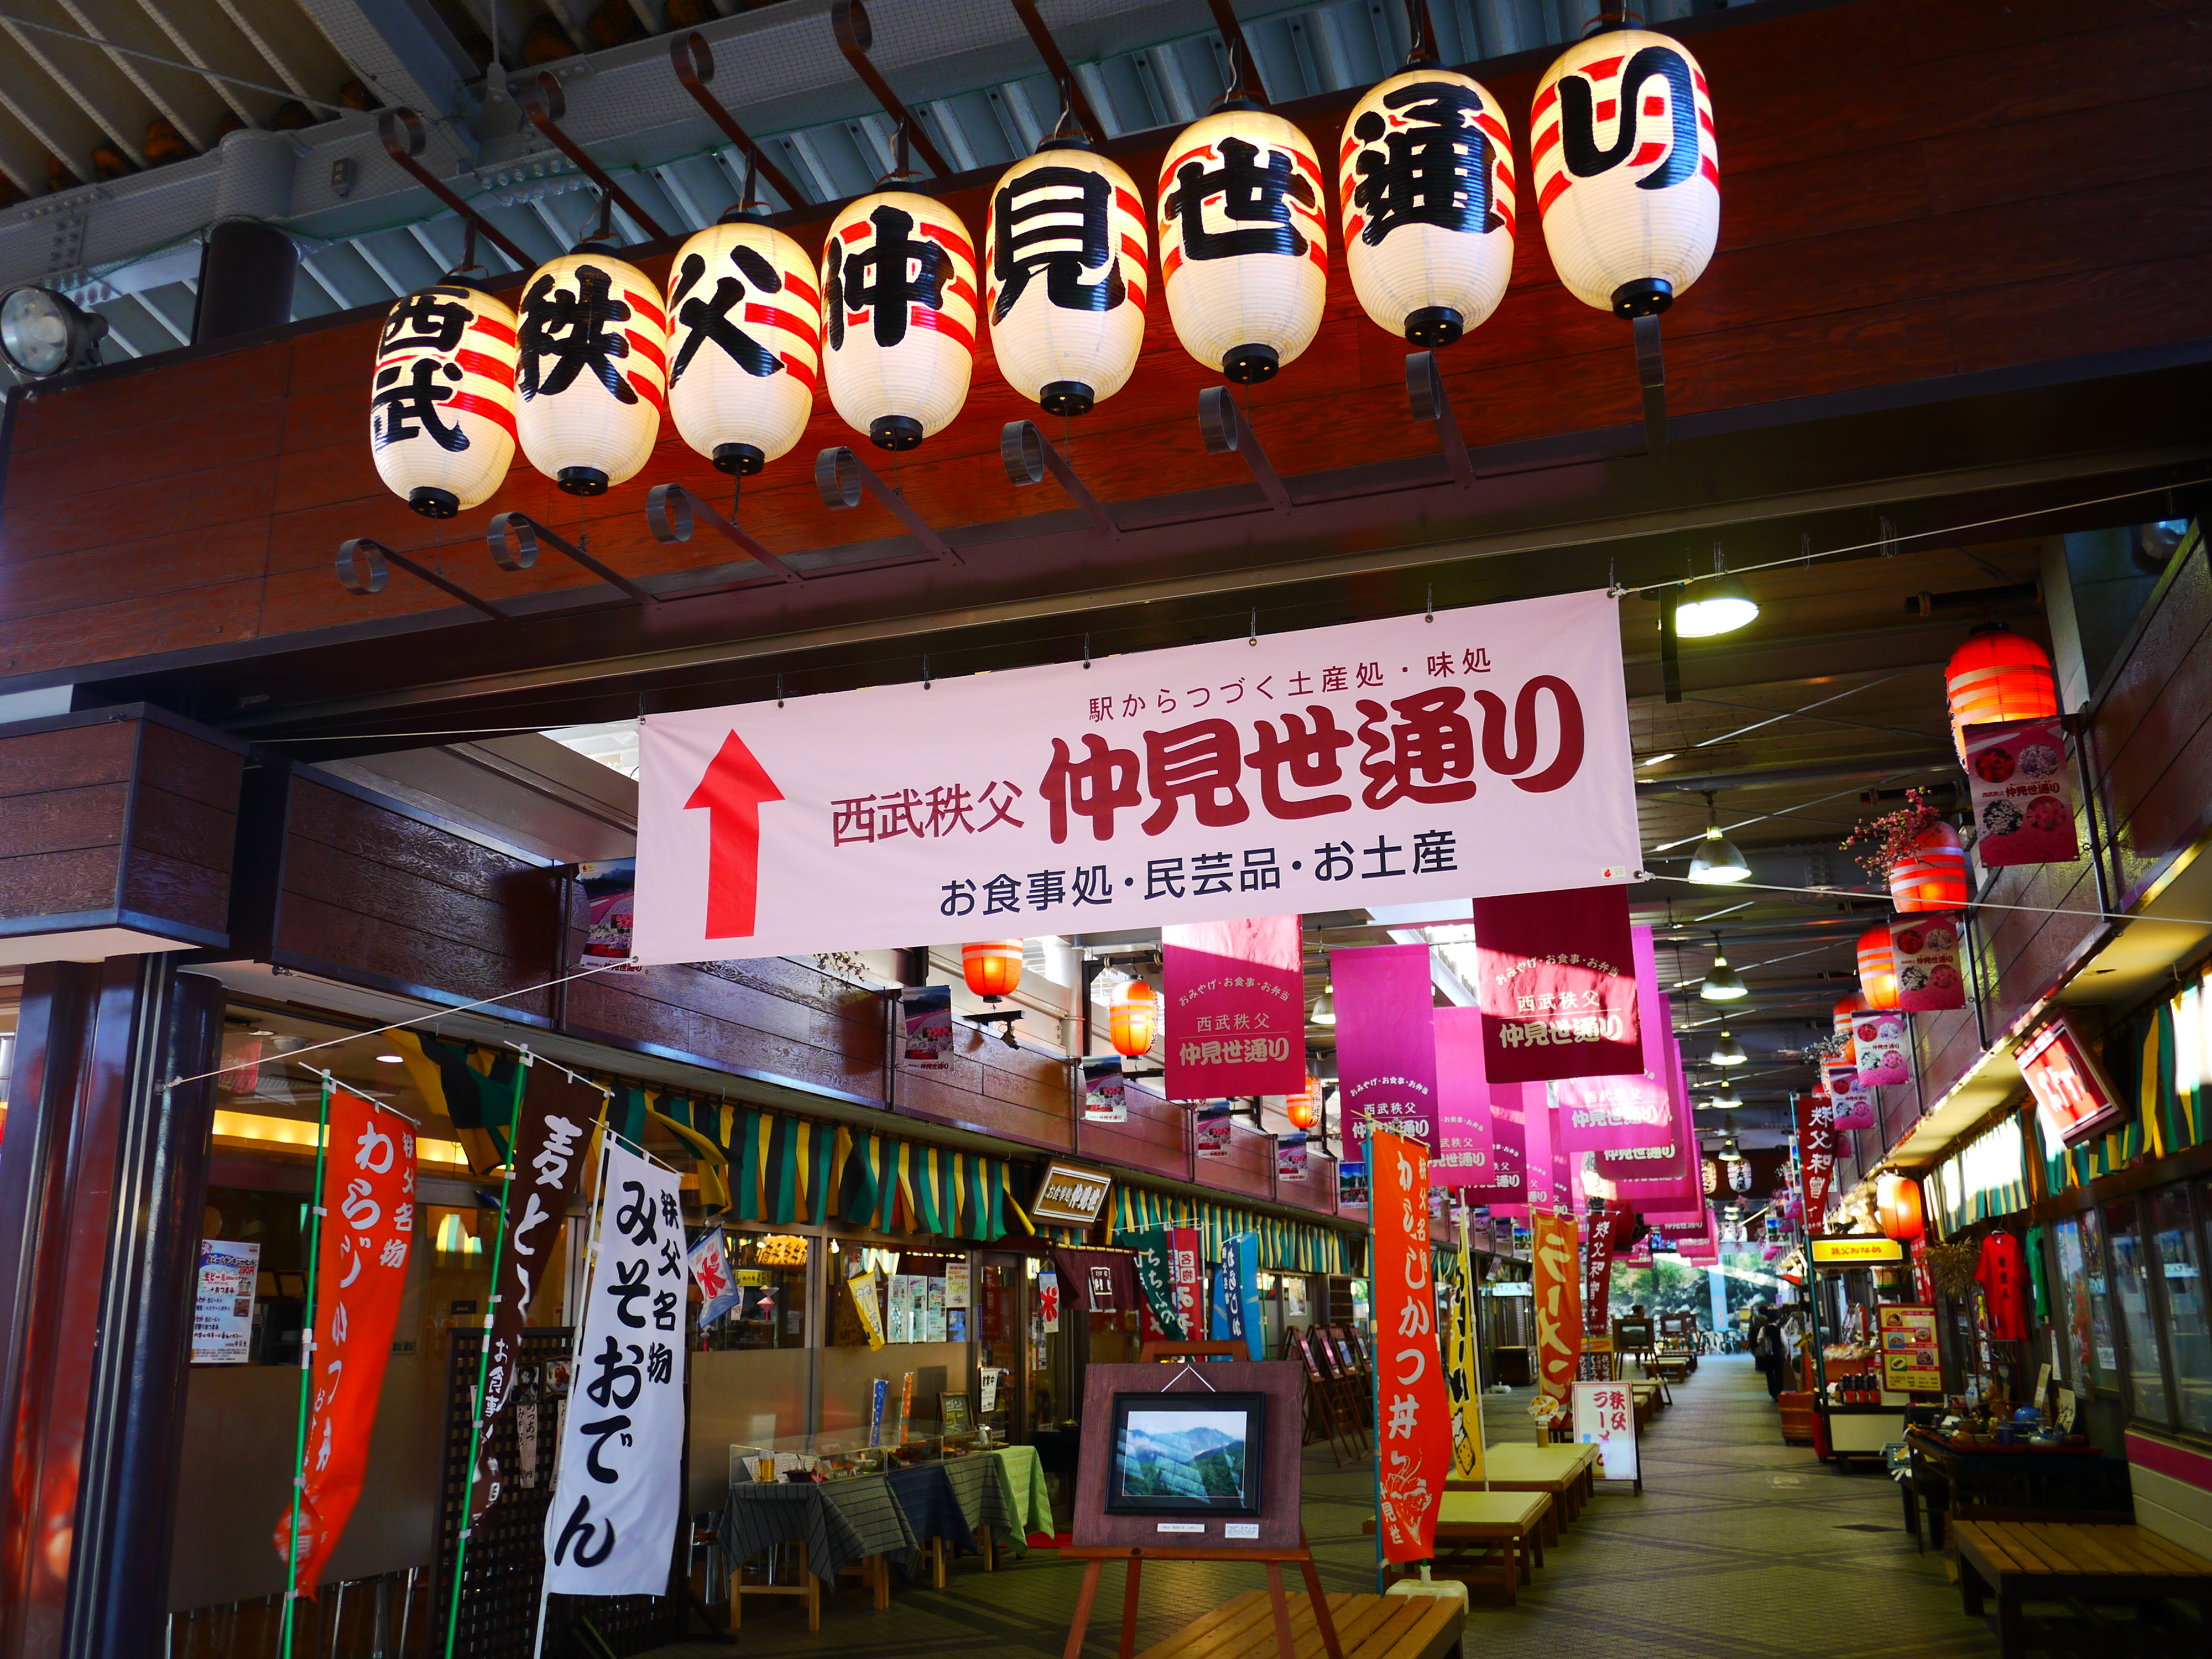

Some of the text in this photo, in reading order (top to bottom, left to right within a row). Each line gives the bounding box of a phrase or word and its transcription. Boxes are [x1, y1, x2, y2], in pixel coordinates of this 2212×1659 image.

[371, 45, 1700, 453] 西武 秩 父 仲 見 世 通 り
[1088, 646, 1493, 722] 駅からつづく土産処・味処
[832, 675, 1585, 847] 西武秩父 仲見世通り
[2006, 783, 2059, 797] 仲見世通り
[940, 828, 1458, 919] お食事処・民芸品・お土産
[1180, 977, 1290, 1007] おみやげ・お食事・お弁当
[1517, 989, 1600, 1013] 西武秩父
[1196, 1014, 1270, 1031] 西武秩父
[1500, 1015, 1623, 1048] 仲見世通り
[1179, 1041, 1290, 1066] 仲見世通り
[1364, 1103, 1416, 1115] 西武秩父
[1572, 1105, 1658, 1128] 仲見世通り
[1352, 1119, 1430, 1139] 仲通り
[1427, 1152, 1485, 1168] 見世通り
[1068, 1183, 1100, 1211] 仲見世
[204, 1272, 226, 1281] 生ビール
[648, 1190, 680, 1385] 秩父名物
[1040, 1285, 1058, 1322] 氷
[1538, 1233, 1572, 1399] ラーメン
[554, 1181, 658, 1569] みそおでん
[1610, 1390, 1626, 1431] 秩父
